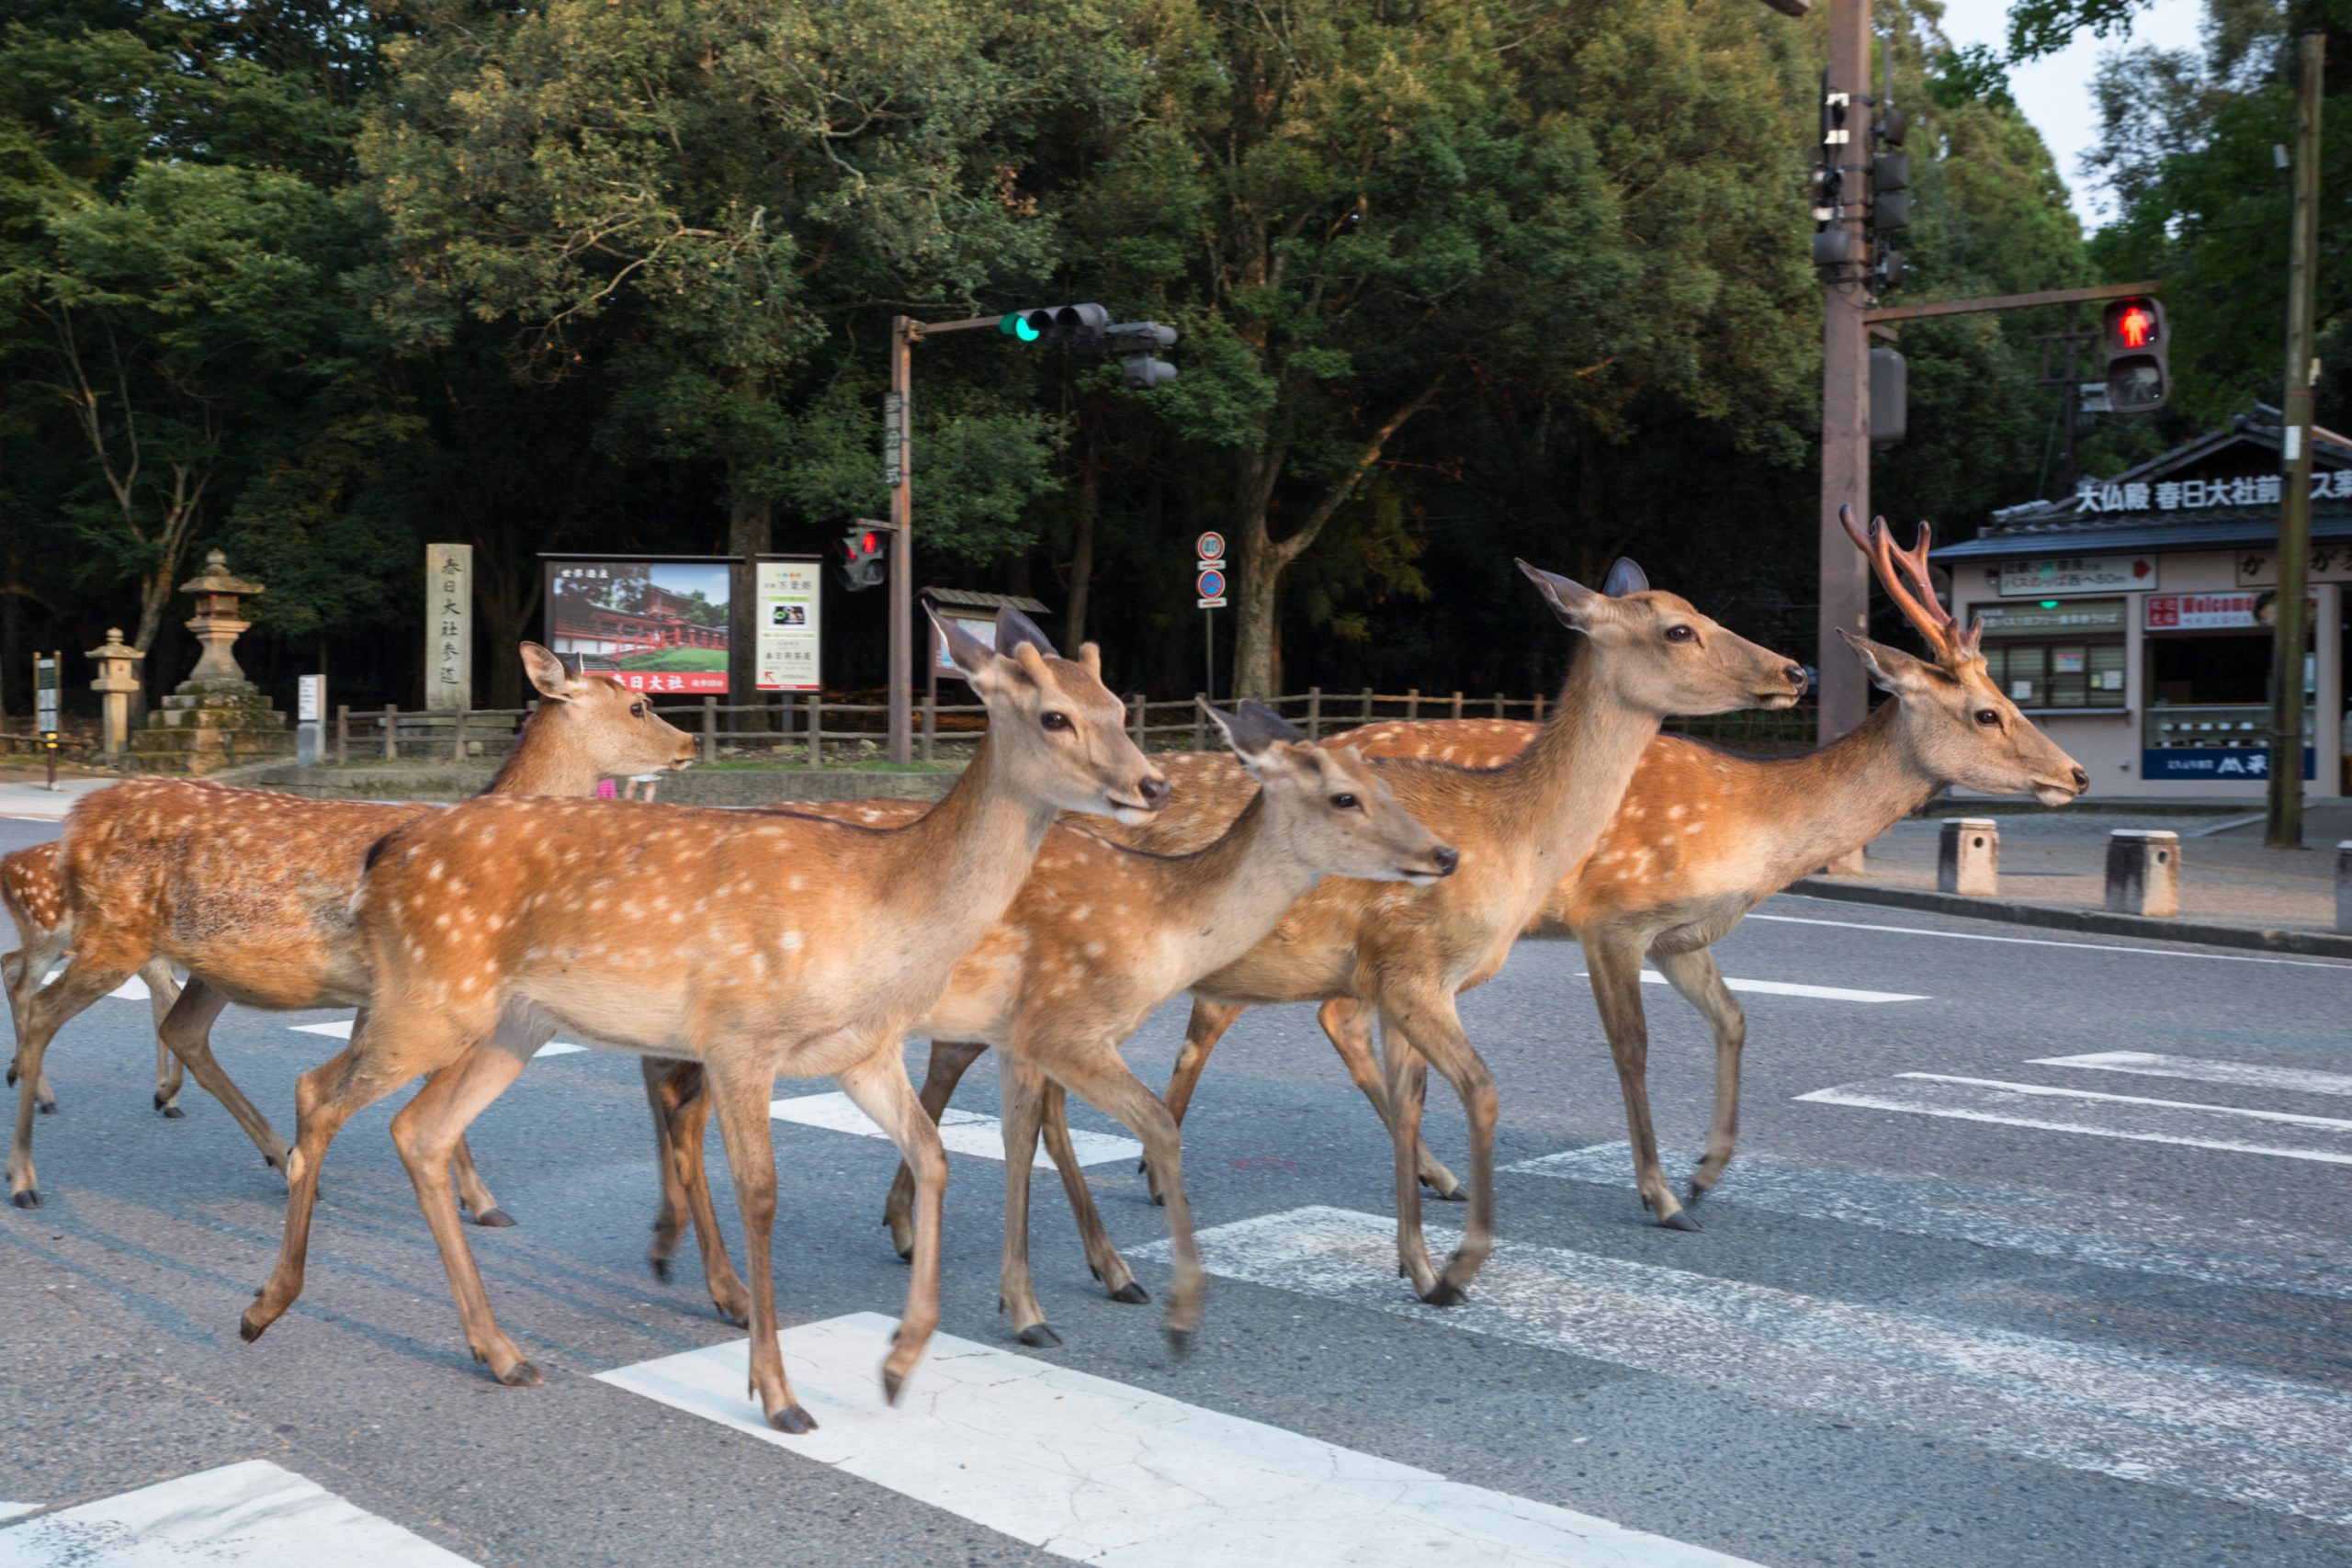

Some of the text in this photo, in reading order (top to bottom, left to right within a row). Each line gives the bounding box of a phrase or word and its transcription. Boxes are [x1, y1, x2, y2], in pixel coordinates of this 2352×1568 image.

[2075, 484, 2151, 513] 大仏殿
[2183, 596, 2255, 613] Welcome
